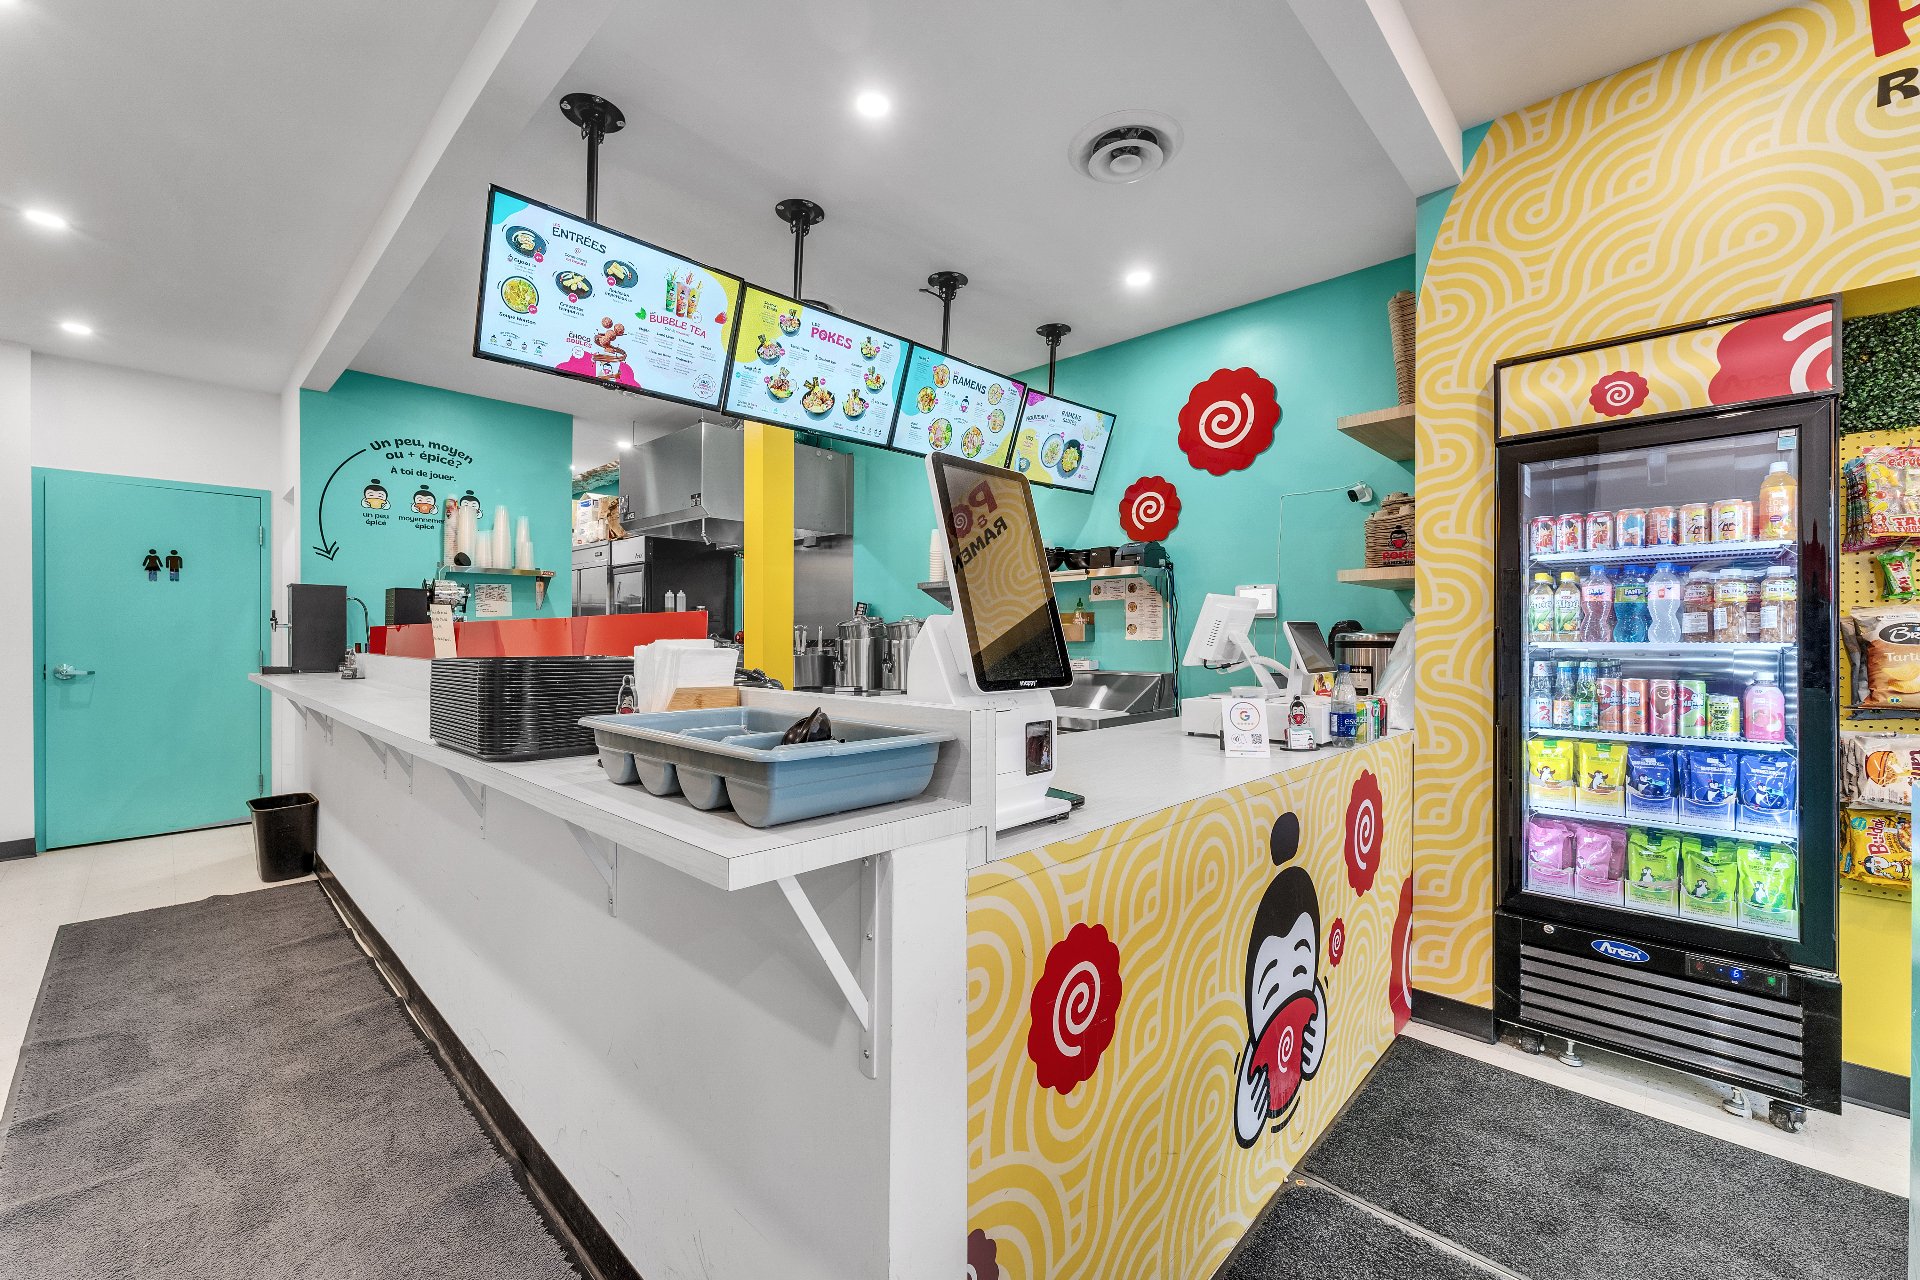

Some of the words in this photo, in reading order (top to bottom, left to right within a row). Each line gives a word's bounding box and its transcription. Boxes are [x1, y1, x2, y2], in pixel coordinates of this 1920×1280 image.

[552, 226, 606, 254] ENTRÉES
[568, 332, 591, 342] CHOCO
[650, 315, 688, 330] BUBBLE
[690, 324, 706, 338] TEA
[811, 327, 852, 350] POKES
[952, 375, 986, 394] RAMENS
[370, 440, 392, 450] Un
[394, 438, 425, 448] peu,
[428, 440, 473, 464] moyen
[386, 451, 404, 460] ou
[420, 450, 462, 468] épicé?
[400, 468, 414, 476] toi
[416, 469, 428, 478] de
[429, 472, 456, 482] jouer.
